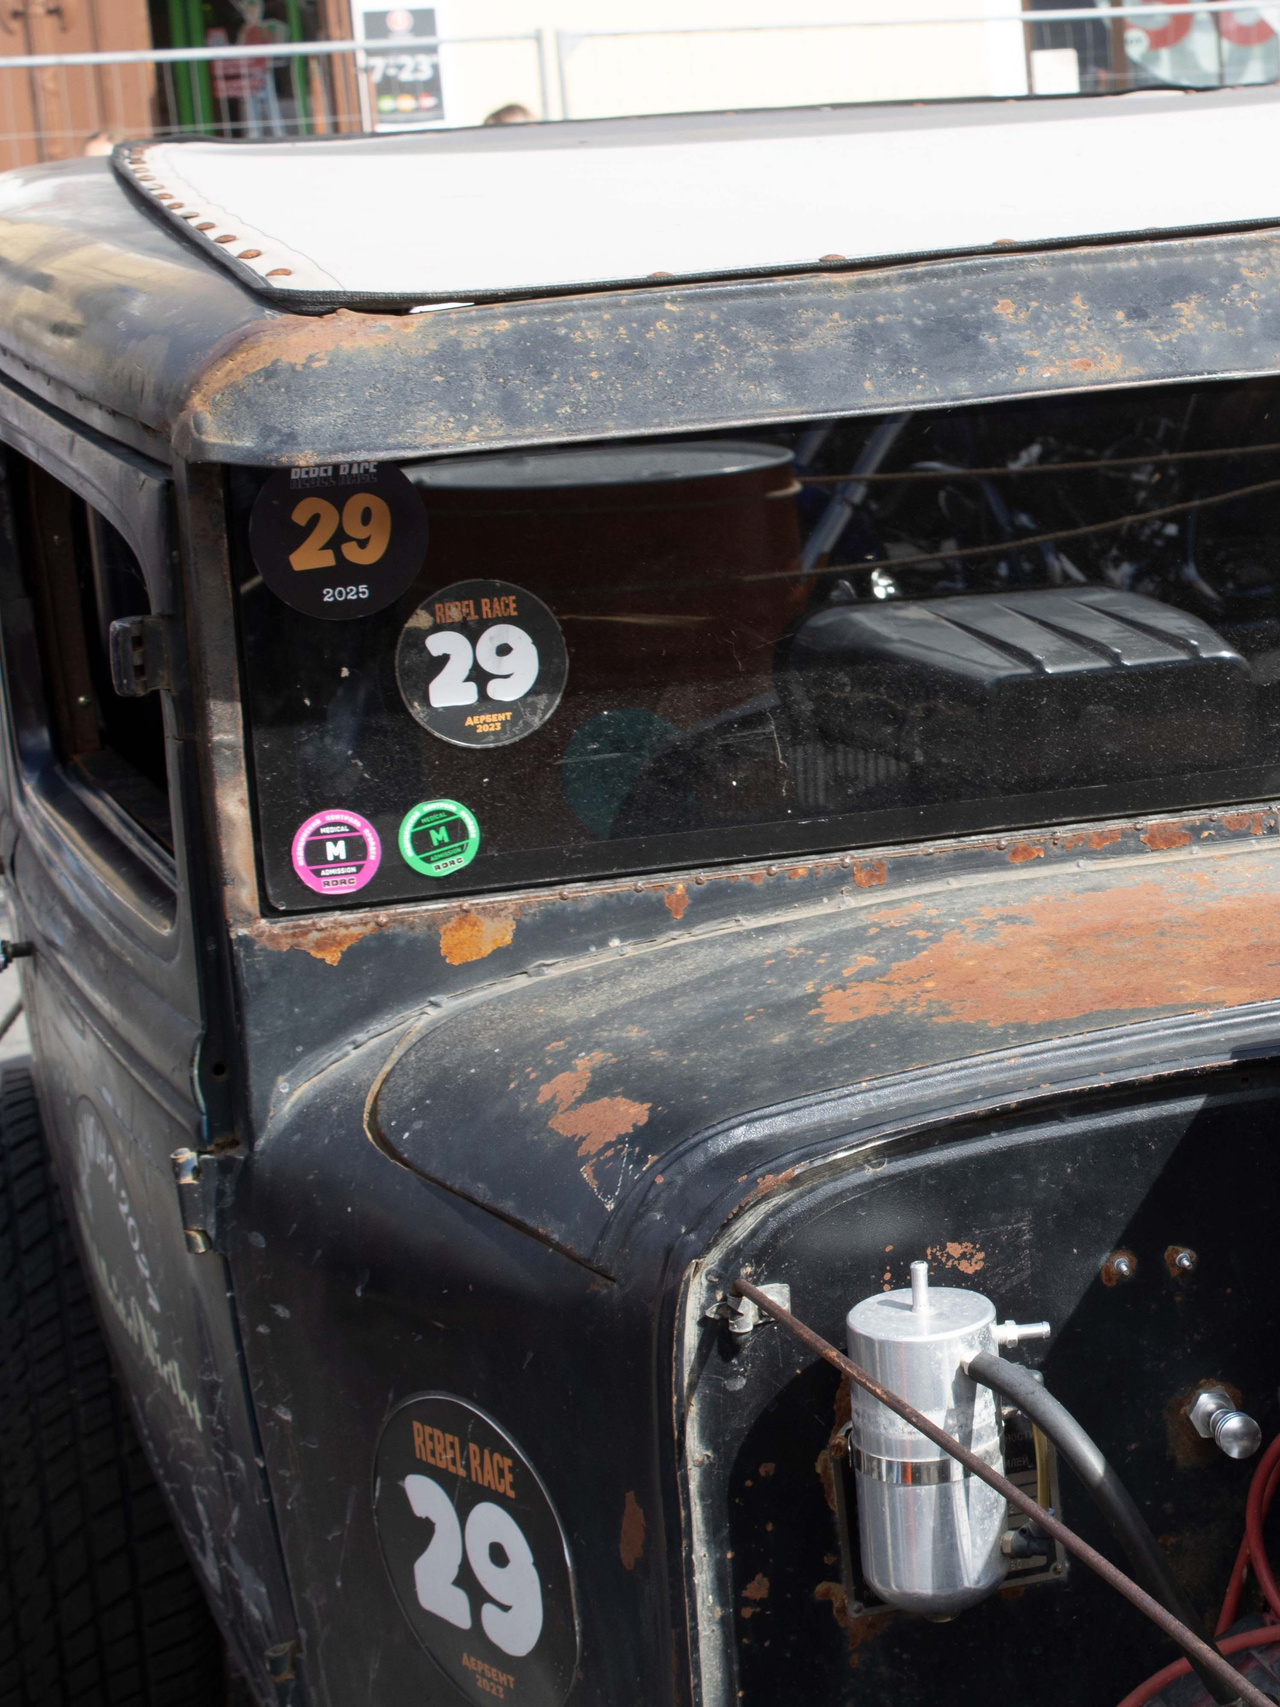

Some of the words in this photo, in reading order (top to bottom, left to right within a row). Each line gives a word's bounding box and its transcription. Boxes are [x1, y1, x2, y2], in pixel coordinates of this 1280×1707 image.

[289, 493, 391, 571] 29
[322, 585, 369, 602] 2025
[435, 600, 479, 624] REBEL
[481, 595, 518, 619] RACE
[425, 623, 540, 708] 29
[476, 722, 502, 733] 2023
[320, 825, 350, 834] MEDICAL
[429, 826, 450, 847] M
[326, 840, 346, 861] M
[320, 866, 357, 876] ADMISSION
[323, 878, 355, 887] RDRC
[412, 1420, 466, 1478] REBEL
[468, 1442, 515, 1499] RACE
[404, 1473, 544, 1657] 29
[476, 1673, 505, 1700] 2023
